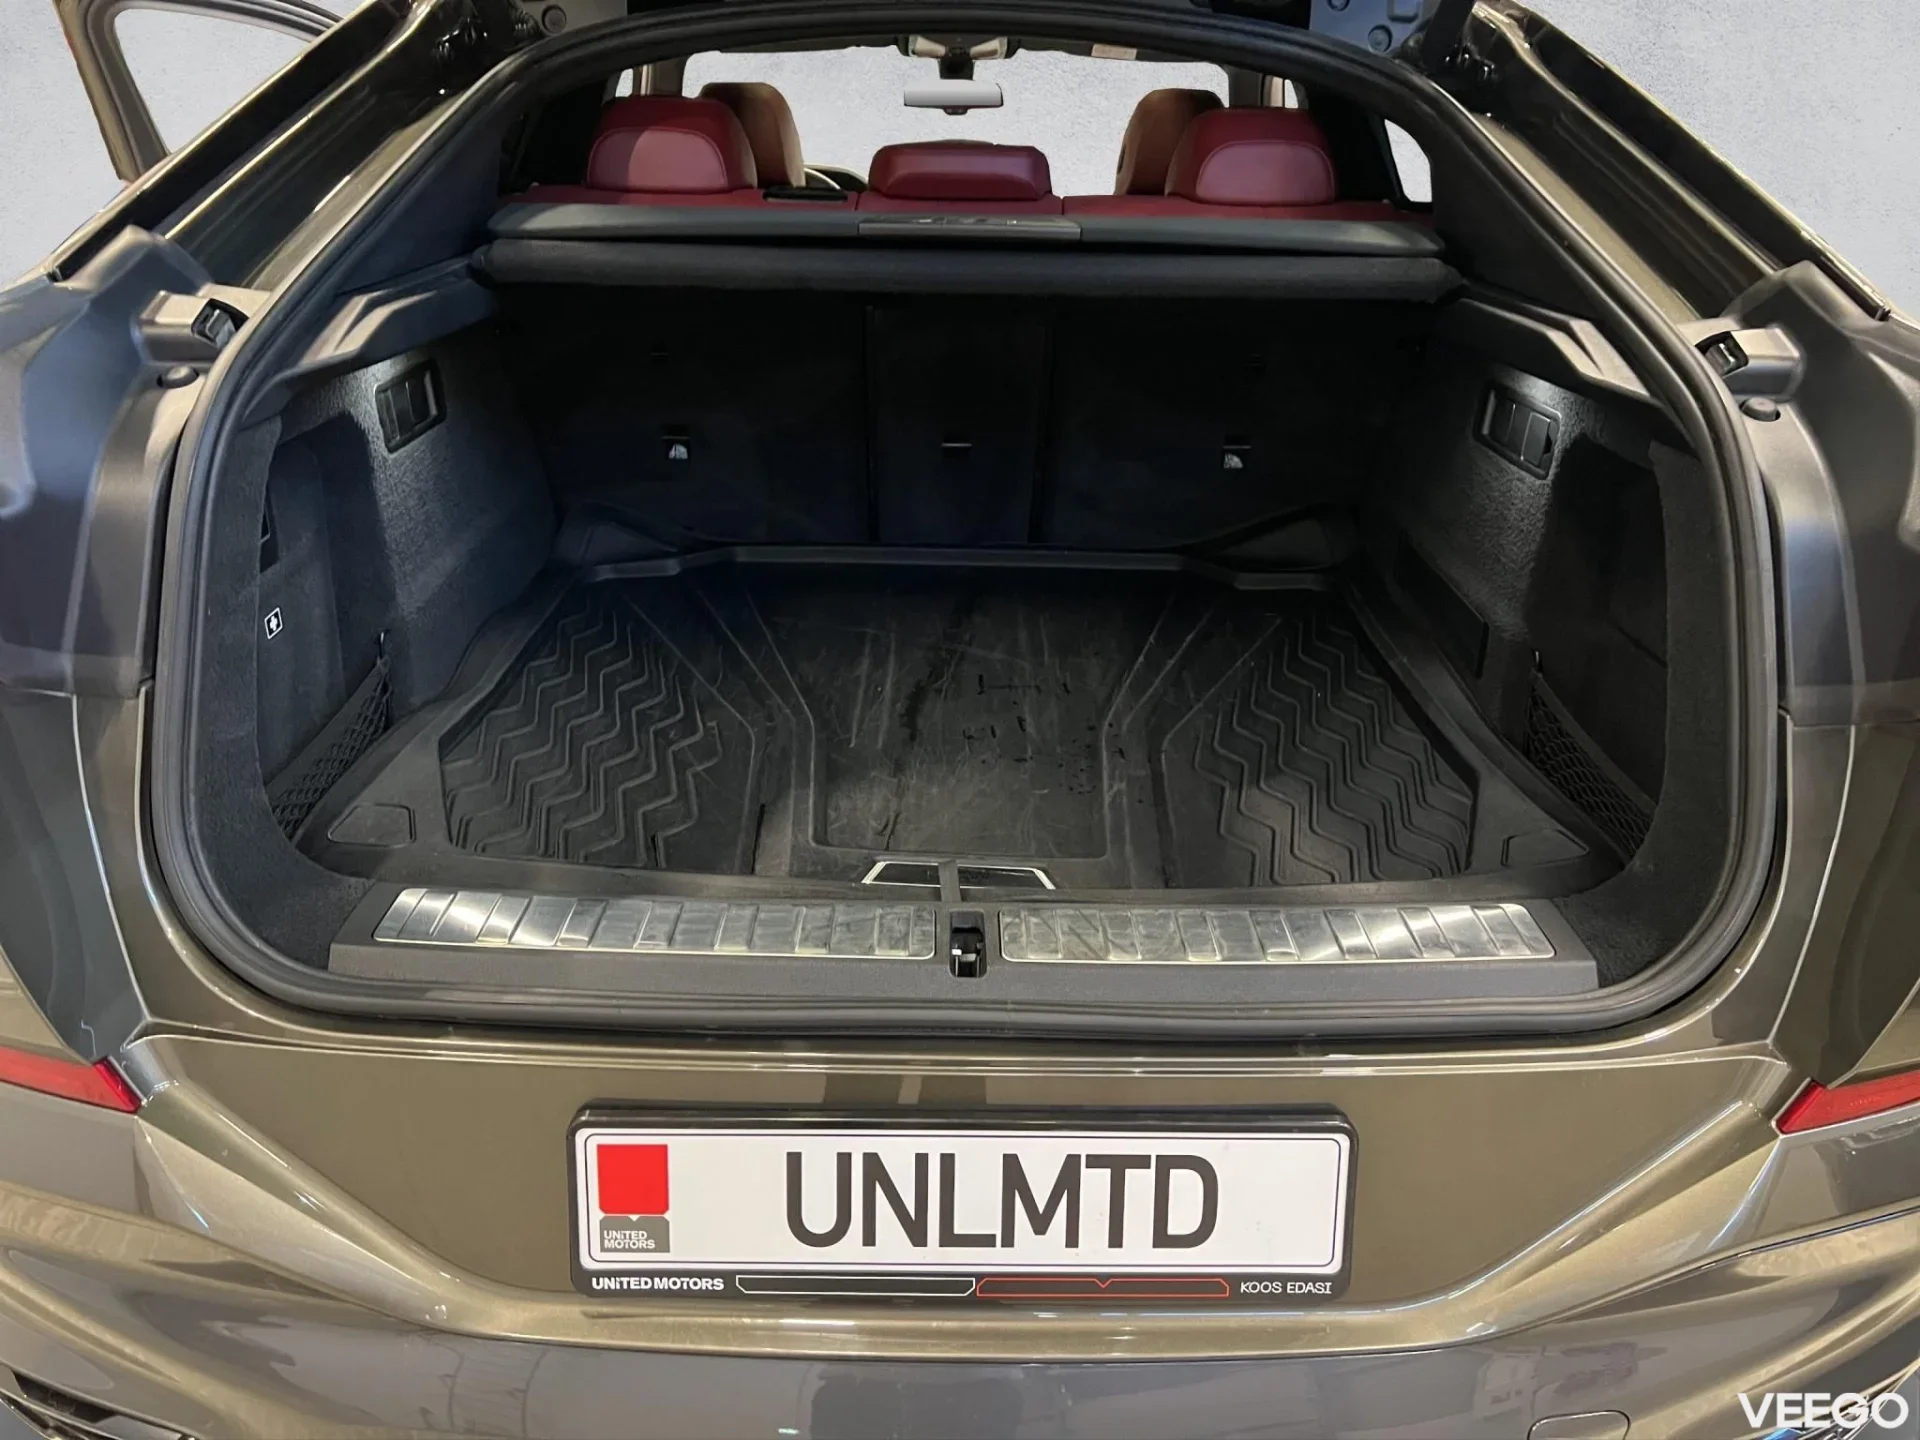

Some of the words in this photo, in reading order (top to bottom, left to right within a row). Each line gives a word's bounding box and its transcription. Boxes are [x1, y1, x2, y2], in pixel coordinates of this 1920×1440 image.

[785, 1151, 1219, 1250] UNLMTD
[604, 1239, 655, 1249] MOTORS
[654, 1277, 724, 1290] MOTORS
[1240, 1281, 1282, 1294] KOOS
[1286, 1282, 1332, 1294] EDASI
